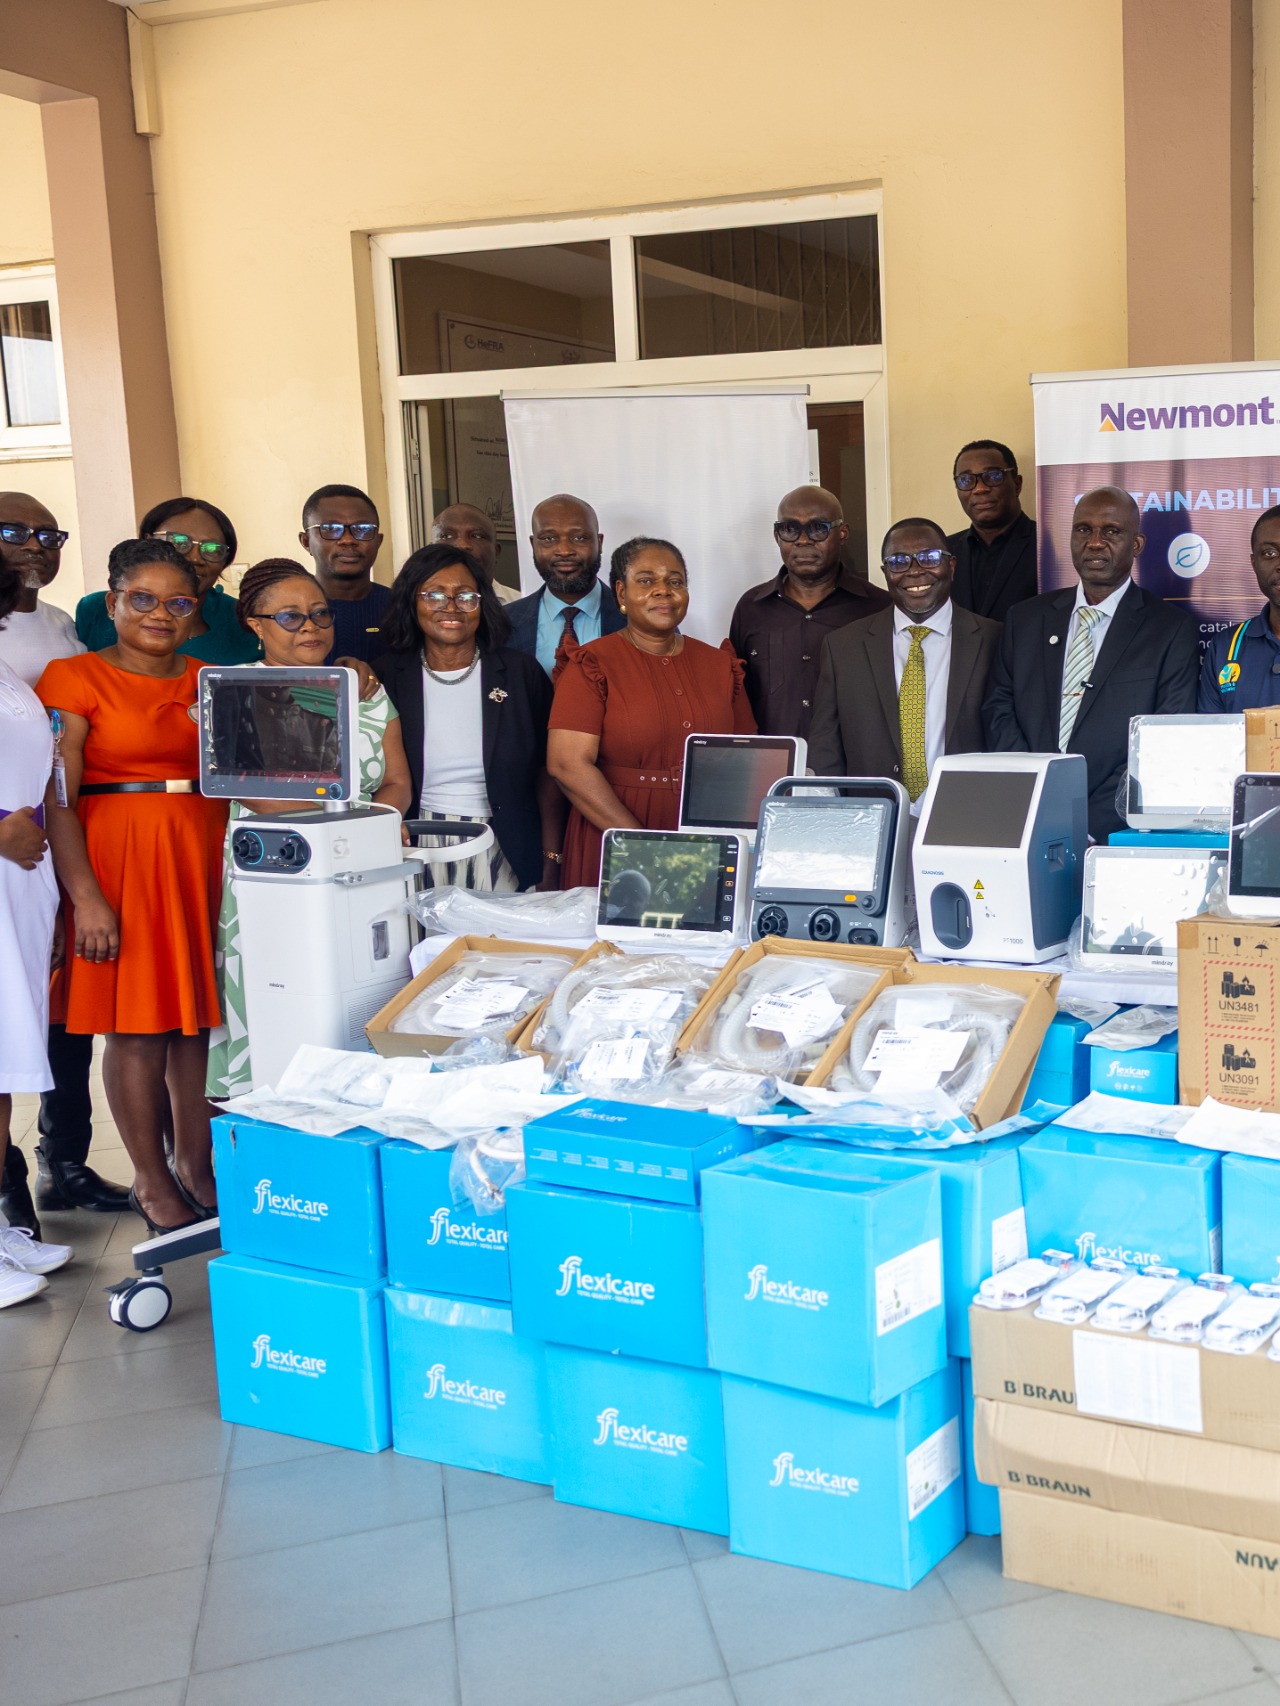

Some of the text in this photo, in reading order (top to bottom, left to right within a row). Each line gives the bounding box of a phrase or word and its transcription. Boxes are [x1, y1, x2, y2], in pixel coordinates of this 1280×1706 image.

[1099, 396, 1275, 432] Newmont
[1218, 1000, 1260, 1013] UN3481
[1106, 1060, 1151, 1077] flexicare
[1219, 1073, 1260, 1085] UN3091
[252, 1178, 329, 1216] flexicare
[555, 1255, 655, 1300] flexicare
[744, 1264, 829, 1306] flexicare
[250, 1334, 327, 1374] flexicare
[424, 1363, 506, 1405] flexicare
[1004, 1380, 1077, 1405] B BRAU
[593, 1407, 689, 1451] flexicare
[769, 1452, 860, 1493] flexicare
[1008, 1470, 1092, 1498] B BRAUN
